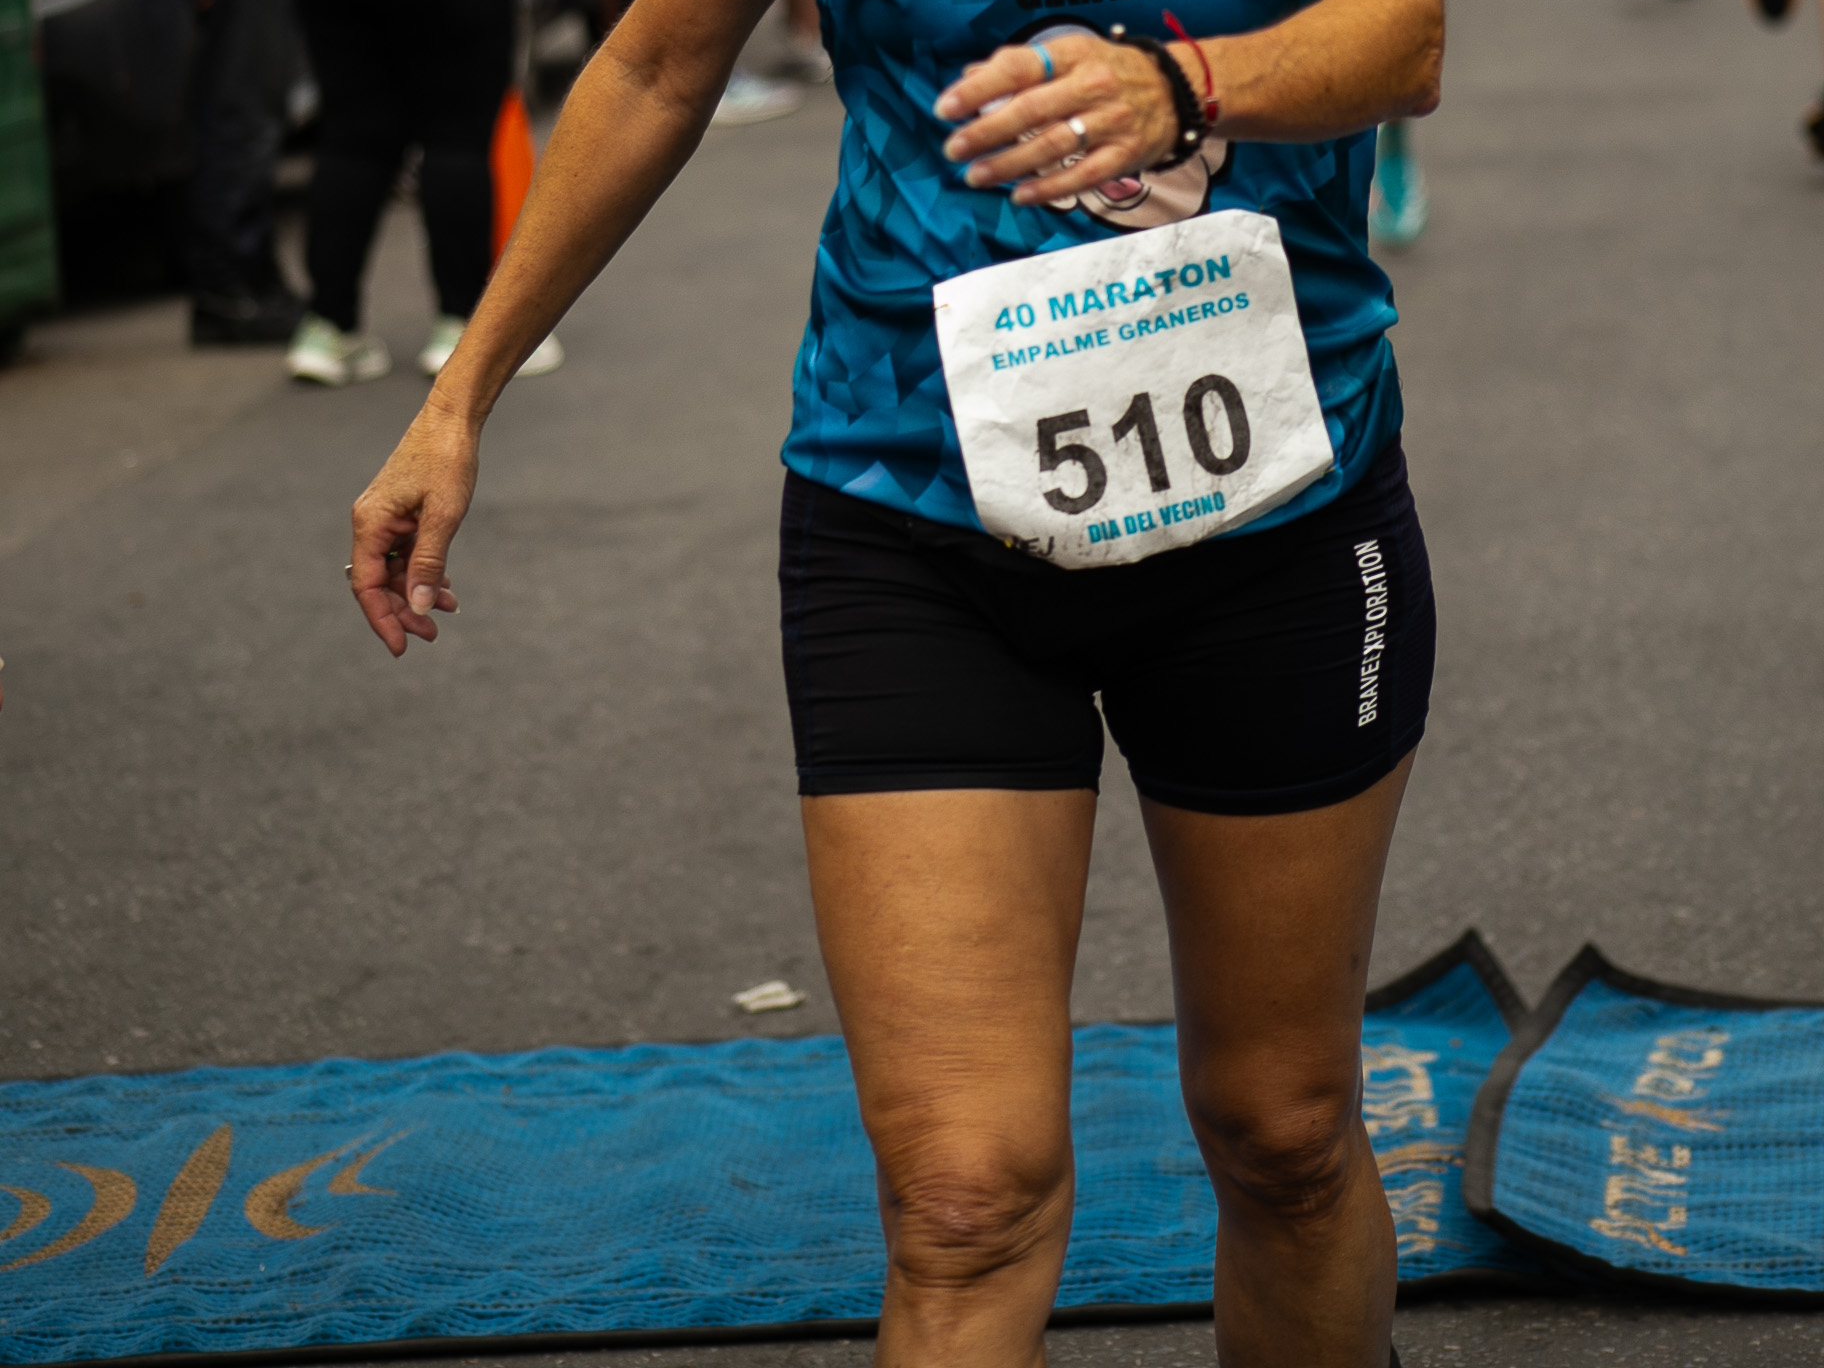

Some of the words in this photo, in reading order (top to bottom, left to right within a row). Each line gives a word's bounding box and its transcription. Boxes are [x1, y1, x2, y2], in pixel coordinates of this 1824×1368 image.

[991, 328, 1112, 372] EMPALME
[1118, 291, 1250, 342] GRANEROS
[994, 303, 1036, 333] 40
[1048, 254, 1232, 322] MARATON
[1036, 373, 1251, 515] 510
[1087, 520, 1122, 544] DIA
[1123, 511, 1157, 536] DEL
[1158, 490, 1226, 526] VECINO
